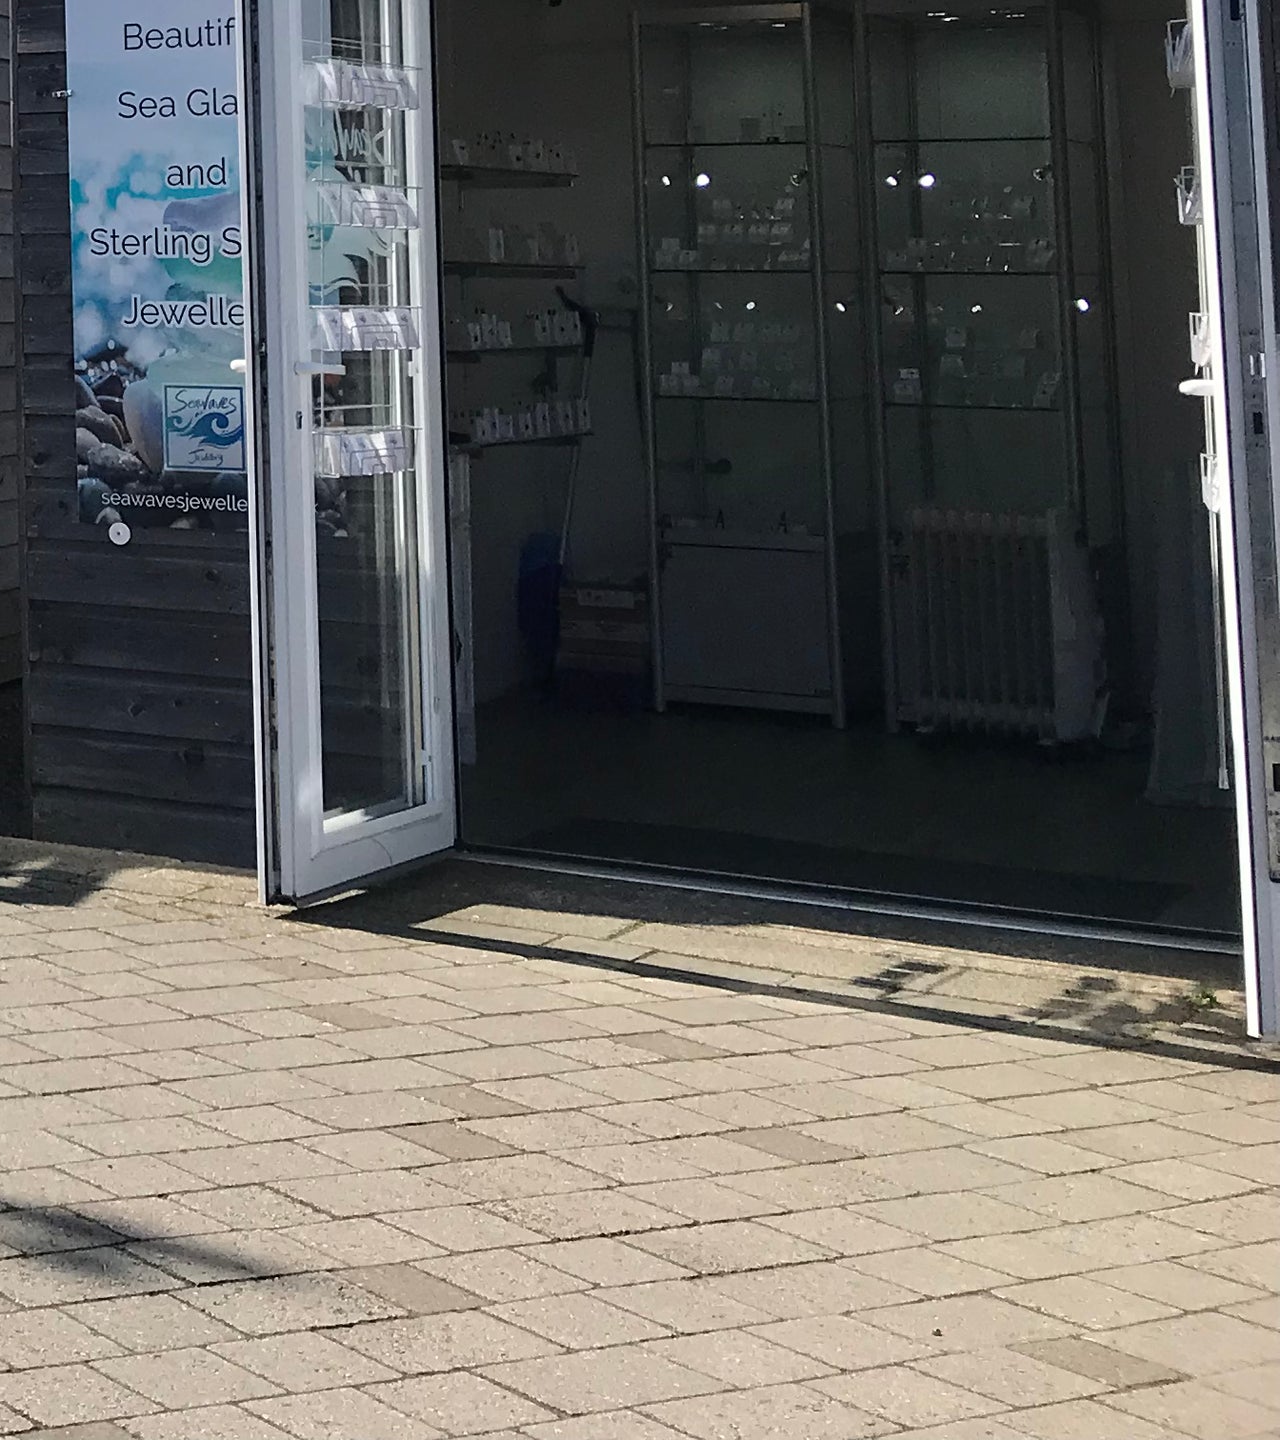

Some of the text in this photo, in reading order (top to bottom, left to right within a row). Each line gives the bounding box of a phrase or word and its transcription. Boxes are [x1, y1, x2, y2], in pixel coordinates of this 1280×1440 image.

[123, 17, 236, 51] Beautif
[118, 87, 239, 119] Sea Gla
[167, 156, 227, 187] and
[90, 226, 210, 263] Sterling
[171, 388, 237, 416] SeaWaves
[100, 491, 249, 512] seawavesjewelle
